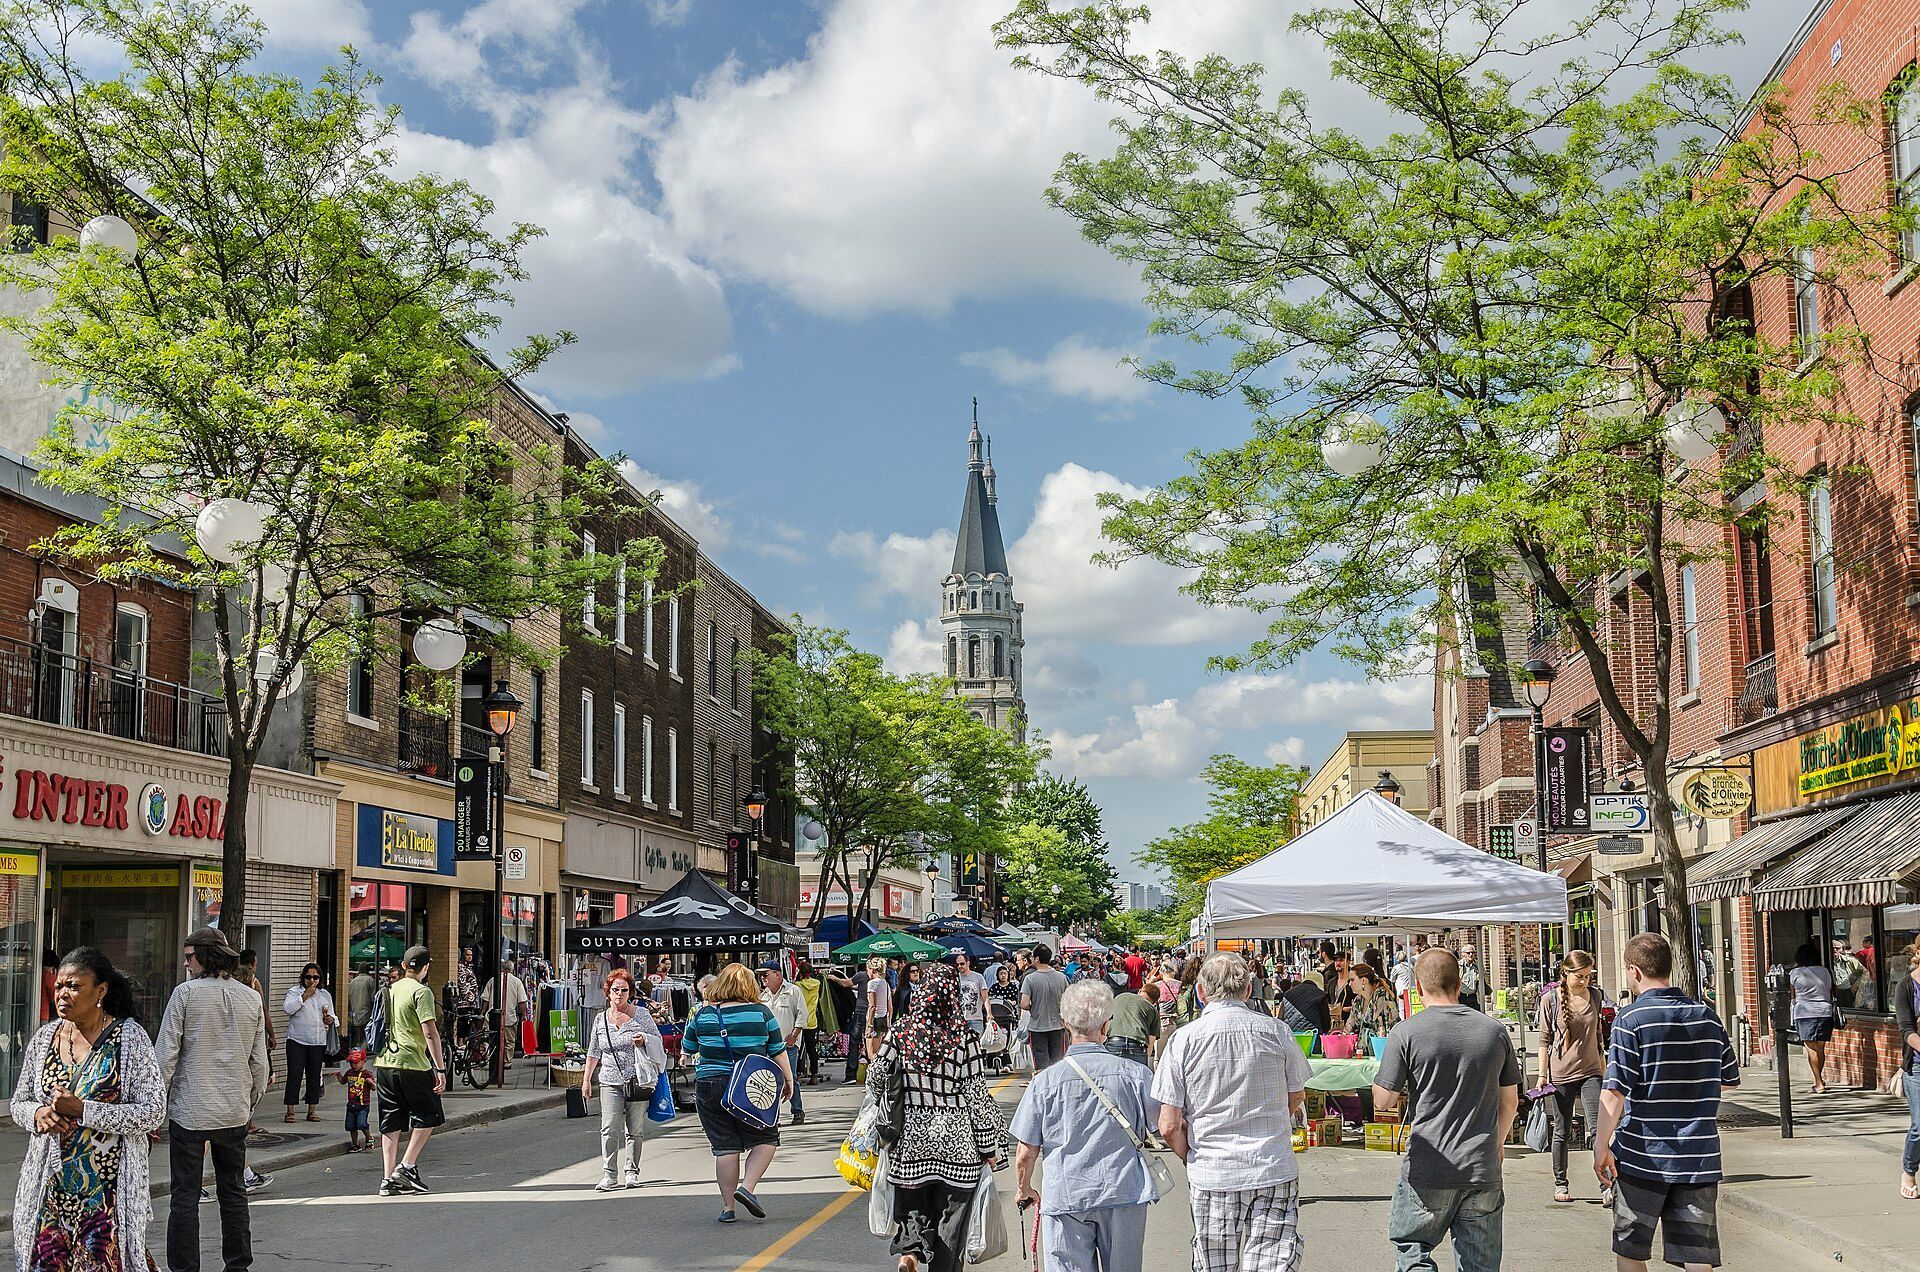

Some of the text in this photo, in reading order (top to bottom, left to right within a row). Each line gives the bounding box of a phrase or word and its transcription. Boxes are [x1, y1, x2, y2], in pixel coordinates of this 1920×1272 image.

[1800, 732, 1837, 773] Branche
[1712, 777, 1743, 789] Branche
[1559, 785, 1566, 795] DU
[1711, 788, 1748, 799] d'Olivier
[12, 769, 129, 830] INTER
[1550, 767, 1559, 826] NOUVEAUTÉS
[1595, 797, 1643, 805] OPTIK
[1595, 811, 1634, 819] INFO
[456, 801, 465, 852] OÙ MANGER
[465, 817, 471, 826] DU
[1560, 817, 1567, 826] AU
[395, 828, 435, 853] La Tienda
[581, 934, 762, 947] OUTDOOR RESEARCH
[556, 1025, 577, 1041] crocs
